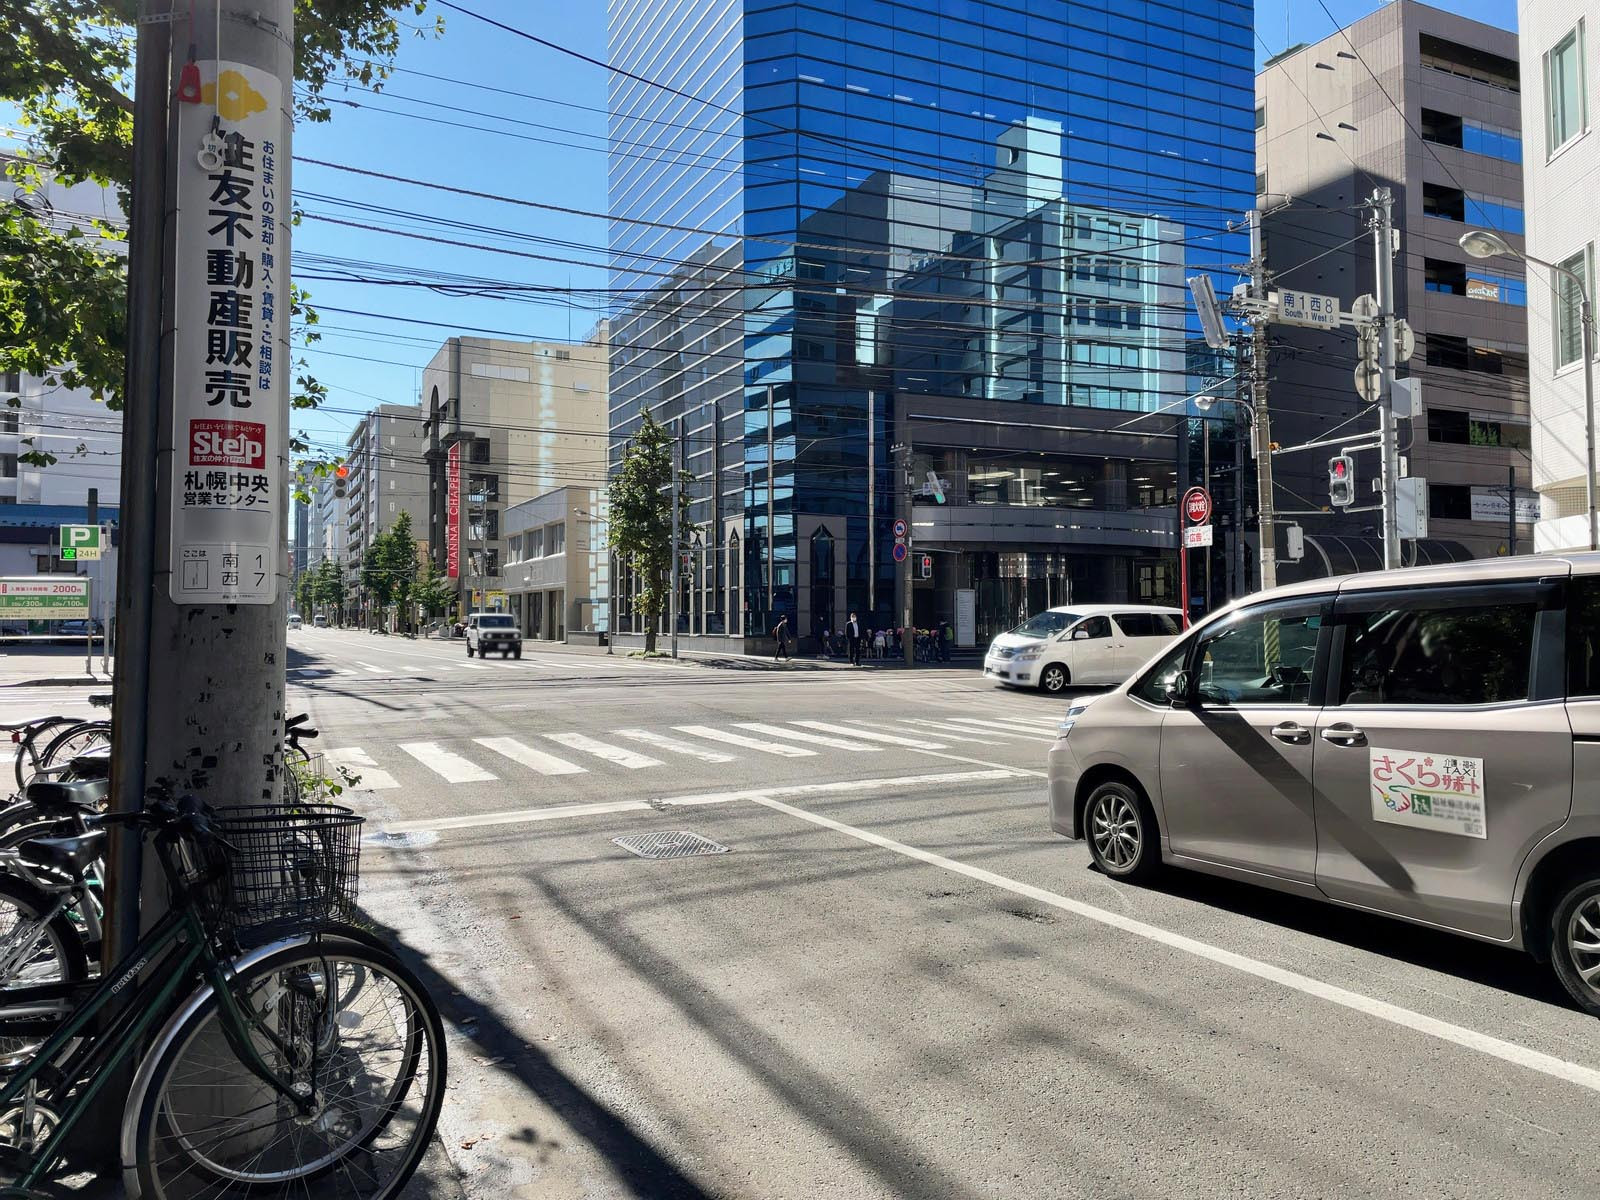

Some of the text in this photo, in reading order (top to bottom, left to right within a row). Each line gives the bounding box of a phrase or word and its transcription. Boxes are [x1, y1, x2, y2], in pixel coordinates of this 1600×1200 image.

[1285, 308, 1304, 319] South
[1311, 312, 1327, 322] West
[1329, 314, 1334, 324] 8
[193, 431, 263, 465] Step
[184, 470, 270, 494] 札幌中央
[183, 492, 269, 506] 営業センター
[449, 470, 459, 570] MANNA CHAPEL
[70, 527, 90, 546] P
[79, 550, 97, 558] 24H
[183, 550, 207, 558] ここは
[222, 553, 262, 568] 南 1
[221, 571, 265, 587] 西 7
[1372, 755, 1441, 788] さくら
[1443, 766, 1477, 778] TAXI
[1442, 774, 1481, 795] サポート
